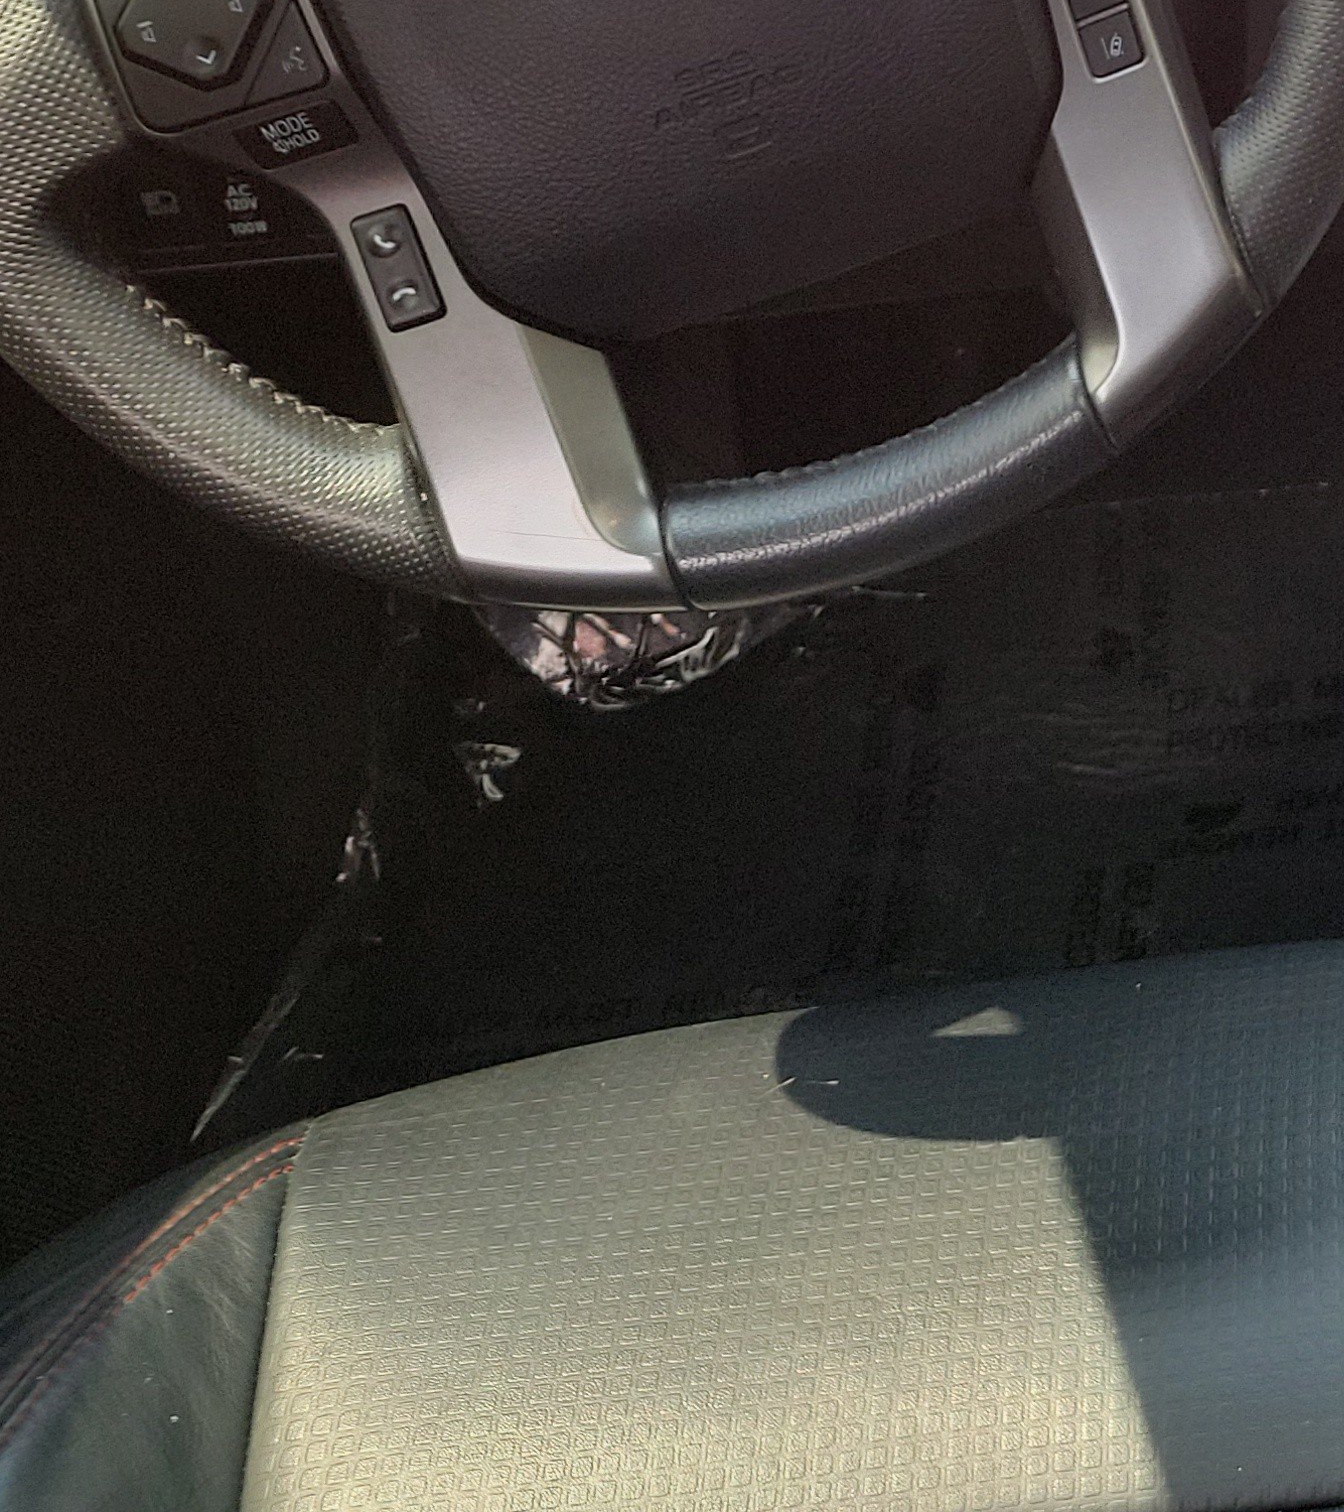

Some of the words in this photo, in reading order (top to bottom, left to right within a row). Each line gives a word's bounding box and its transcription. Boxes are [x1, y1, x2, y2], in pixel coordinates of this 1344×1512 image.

[259, 110, 315, 143] MODE
[285, 128, 322, 153] HOLD
[227, 183, 252, 198] AC
